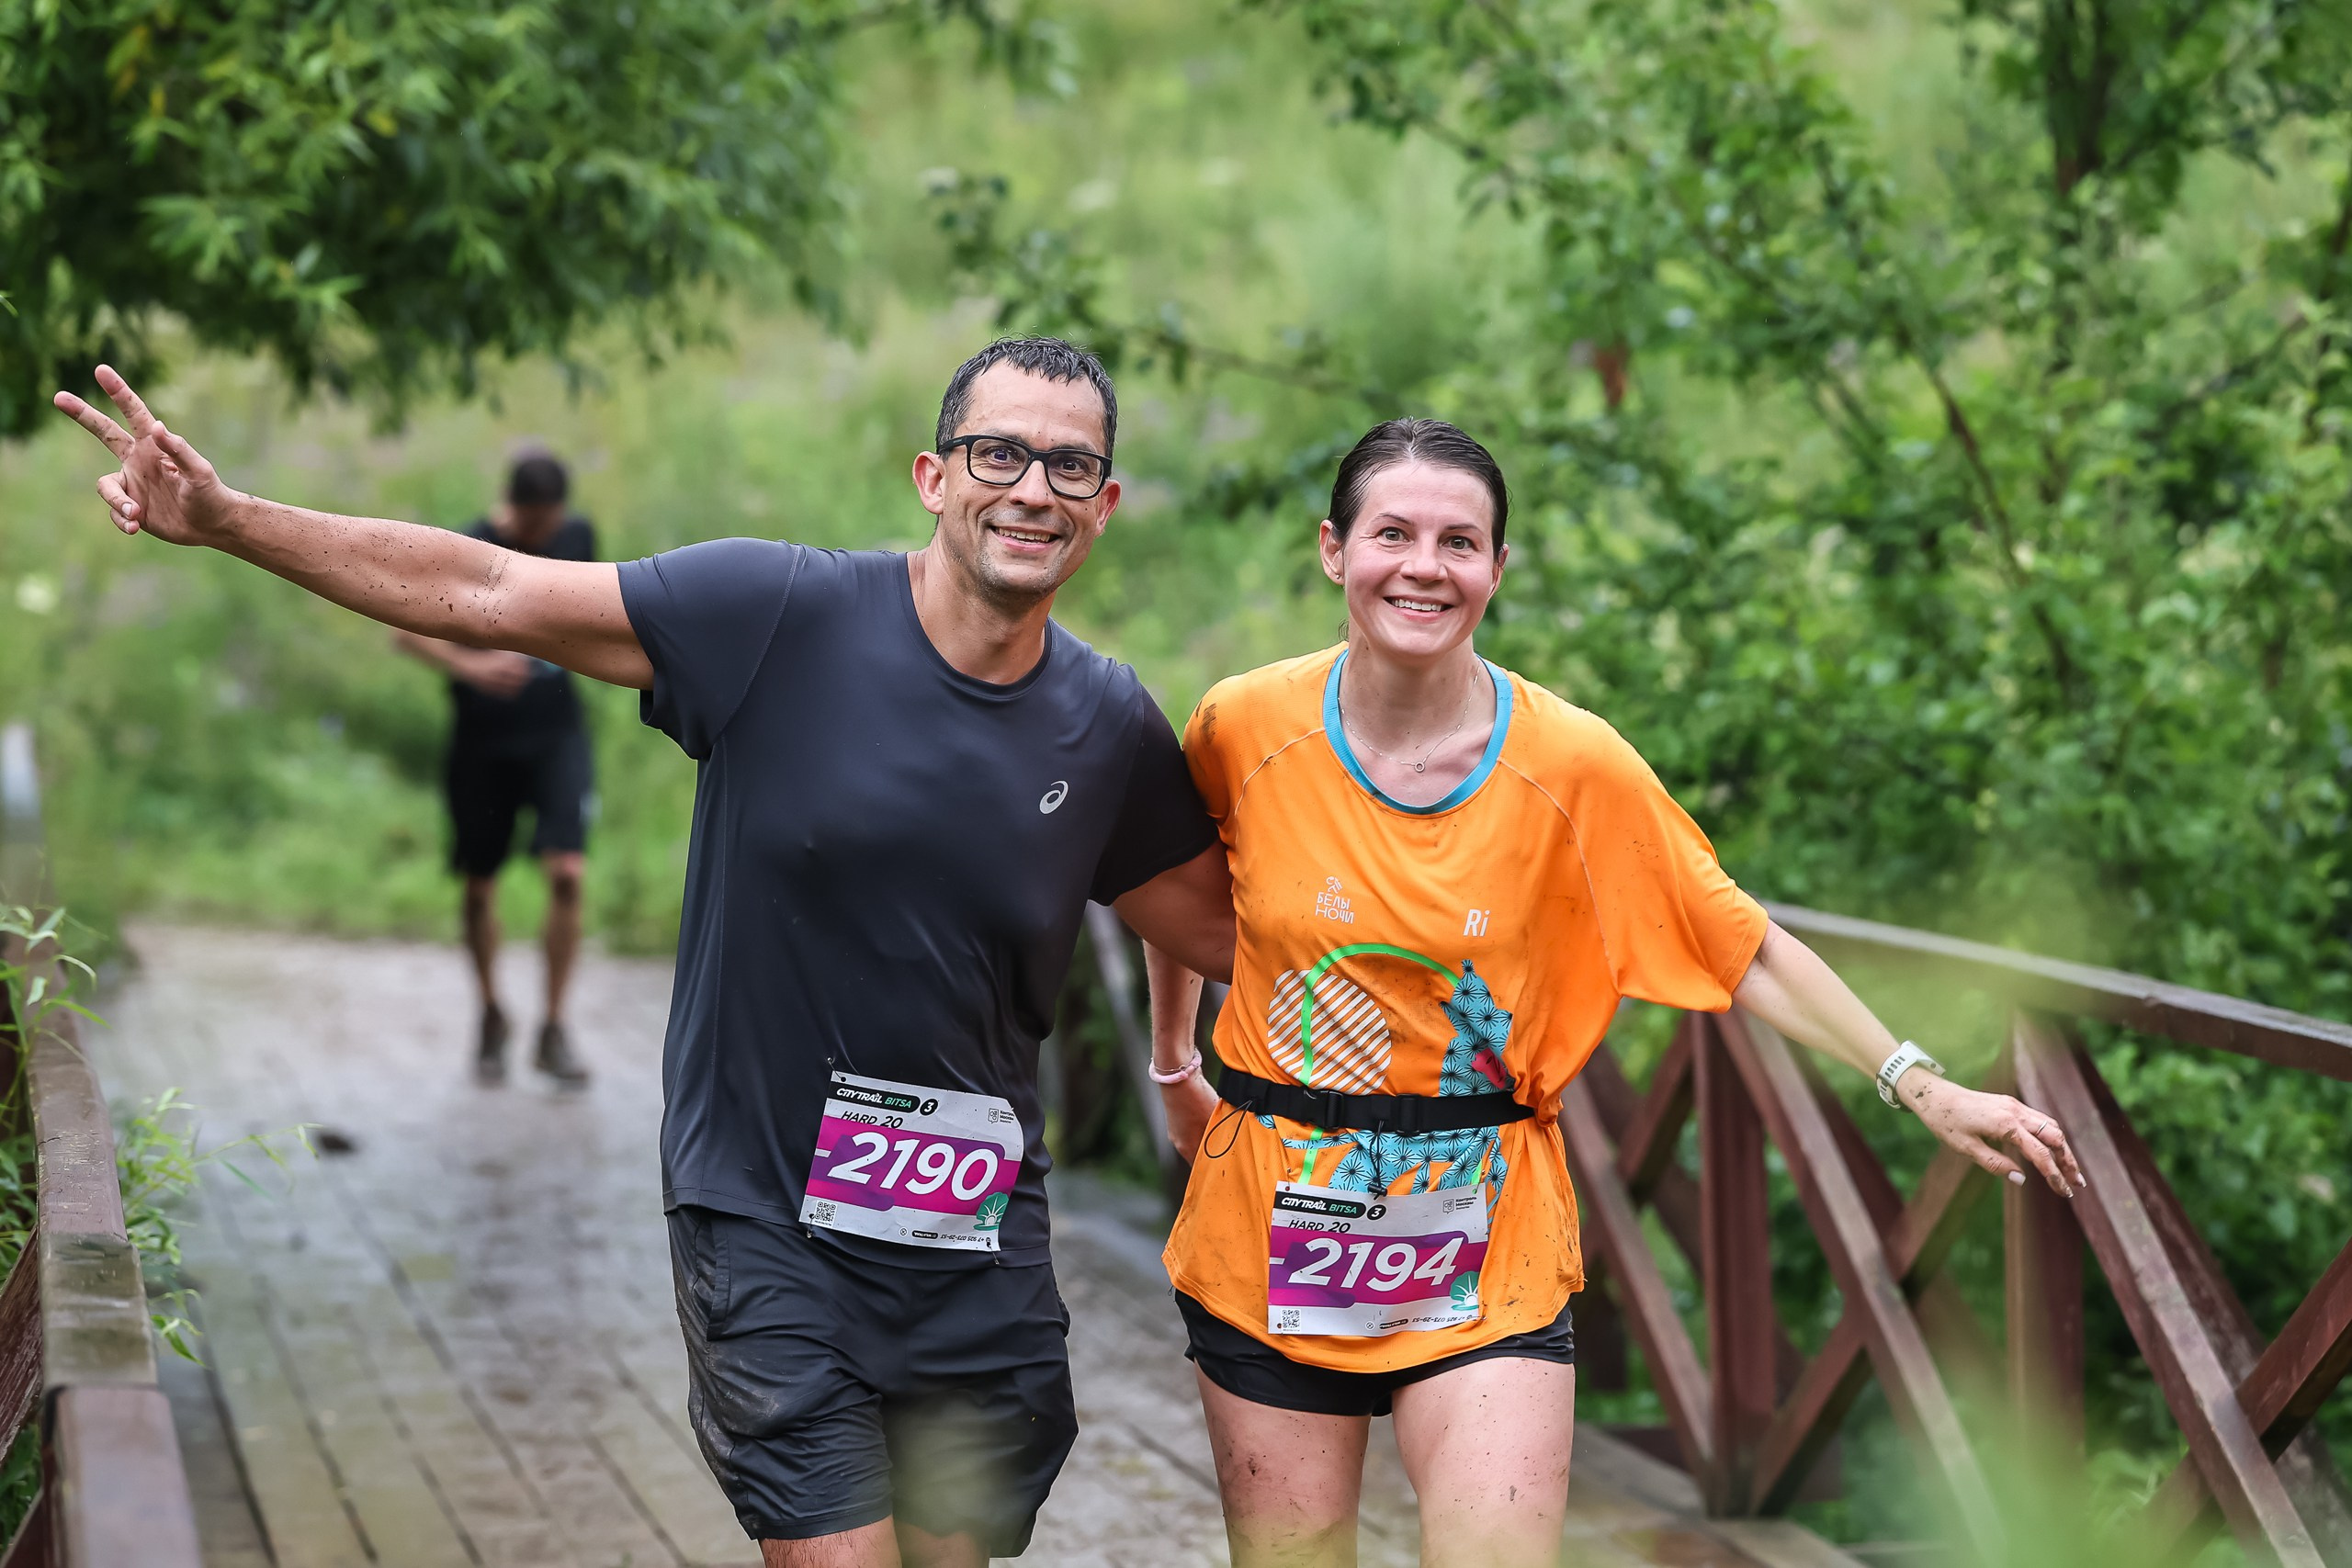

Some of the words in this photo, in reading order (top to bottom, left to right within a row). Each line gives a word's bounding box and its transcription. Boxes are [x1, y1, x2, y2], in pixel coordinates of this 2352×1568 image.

[1315, 905, 1355, 925] НОЧИ
[1463, 908, 1490, 937] Ri
[884, 1097, 912, 1109] BITSA
[923, 1101, 935, 1113] 3
[841, 1111, 878, 1125] HARD
[880, 1115, 904, 1129] 20
[827, 1132, 1000, 1201] 2190
[1329, 1203, 1357, 1214] BITSA
[1371, 1207, 1382, 1218] 3
[1288, 1220, 1325, 1232] HARD
[1328, 1222, 1351, 1234] 20
[1287, 1237, 1464, 1292] 2194
